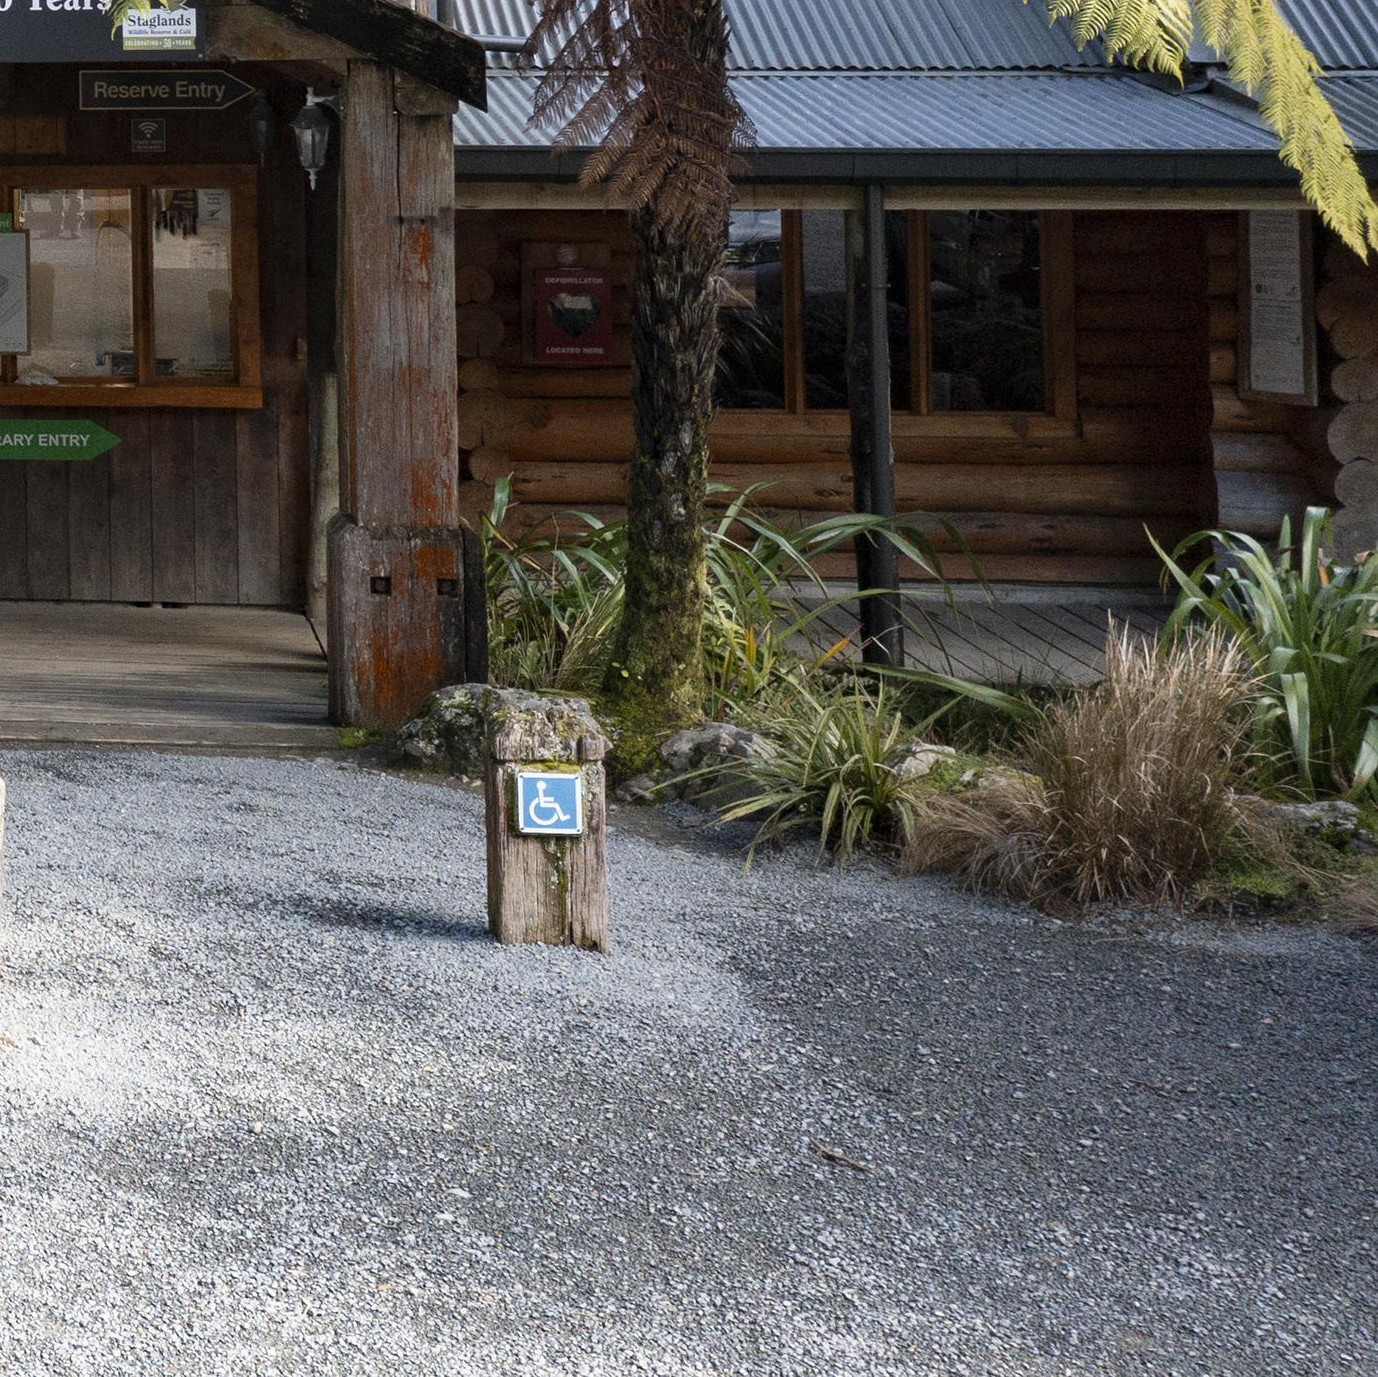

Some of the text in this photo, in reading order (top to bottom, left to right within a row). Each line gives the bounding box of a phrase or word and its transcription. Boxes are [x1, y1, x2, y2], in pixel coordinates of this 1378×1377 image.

[127, 14, 191, 29] Staglands
[163, 38, 172, 48] 50
[94, 81, 226, 102] Reserve Entry
[38, 434, 90, 447] ENTRY
